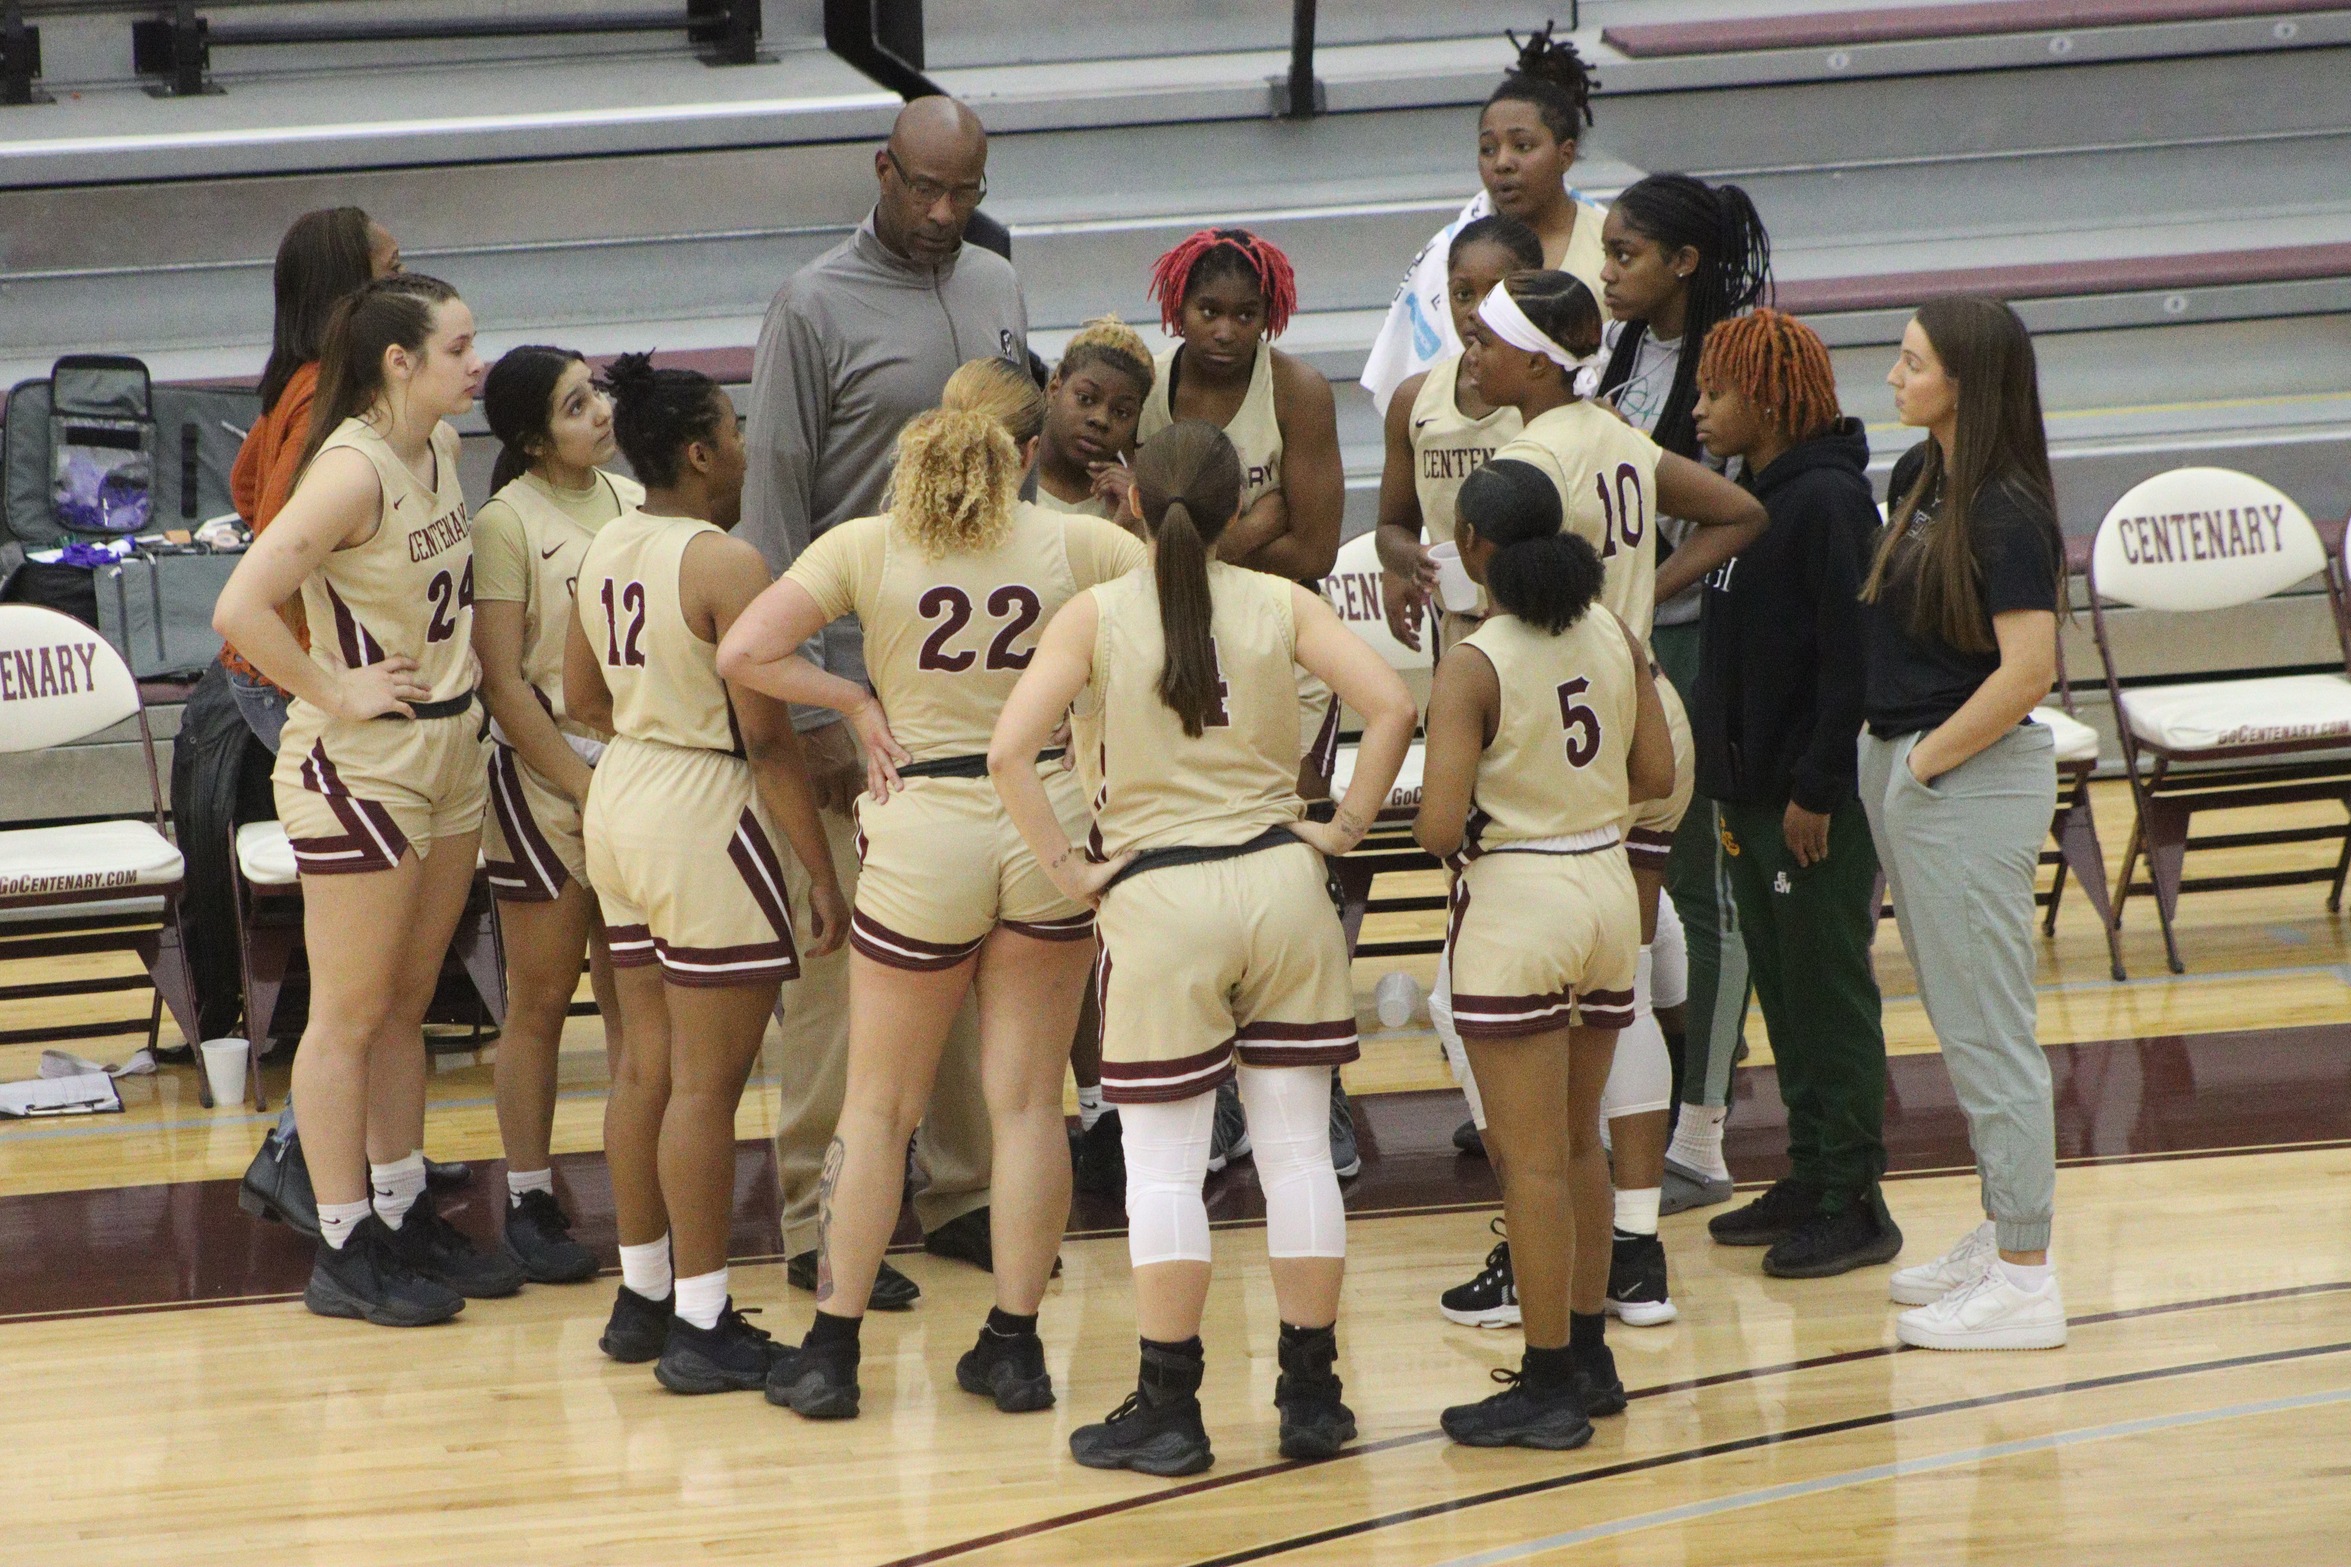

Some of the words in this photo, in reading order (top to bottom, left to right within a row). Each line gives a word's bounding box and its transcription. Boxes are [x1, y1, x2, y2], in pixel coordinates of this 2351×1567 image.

[1595, 461, 1644, 559] 10
[2117, 503, 2284, 565] CENTENARY
[426, 551, 475, 643] 24
[601, 577, 646, 669] 12
[917, 584, 1042, 673] 22
[1324, 572, 1384, 622] CEN
[0, 642, 97, 702] ENARY
[1556, 675, 1602, 769] 5
